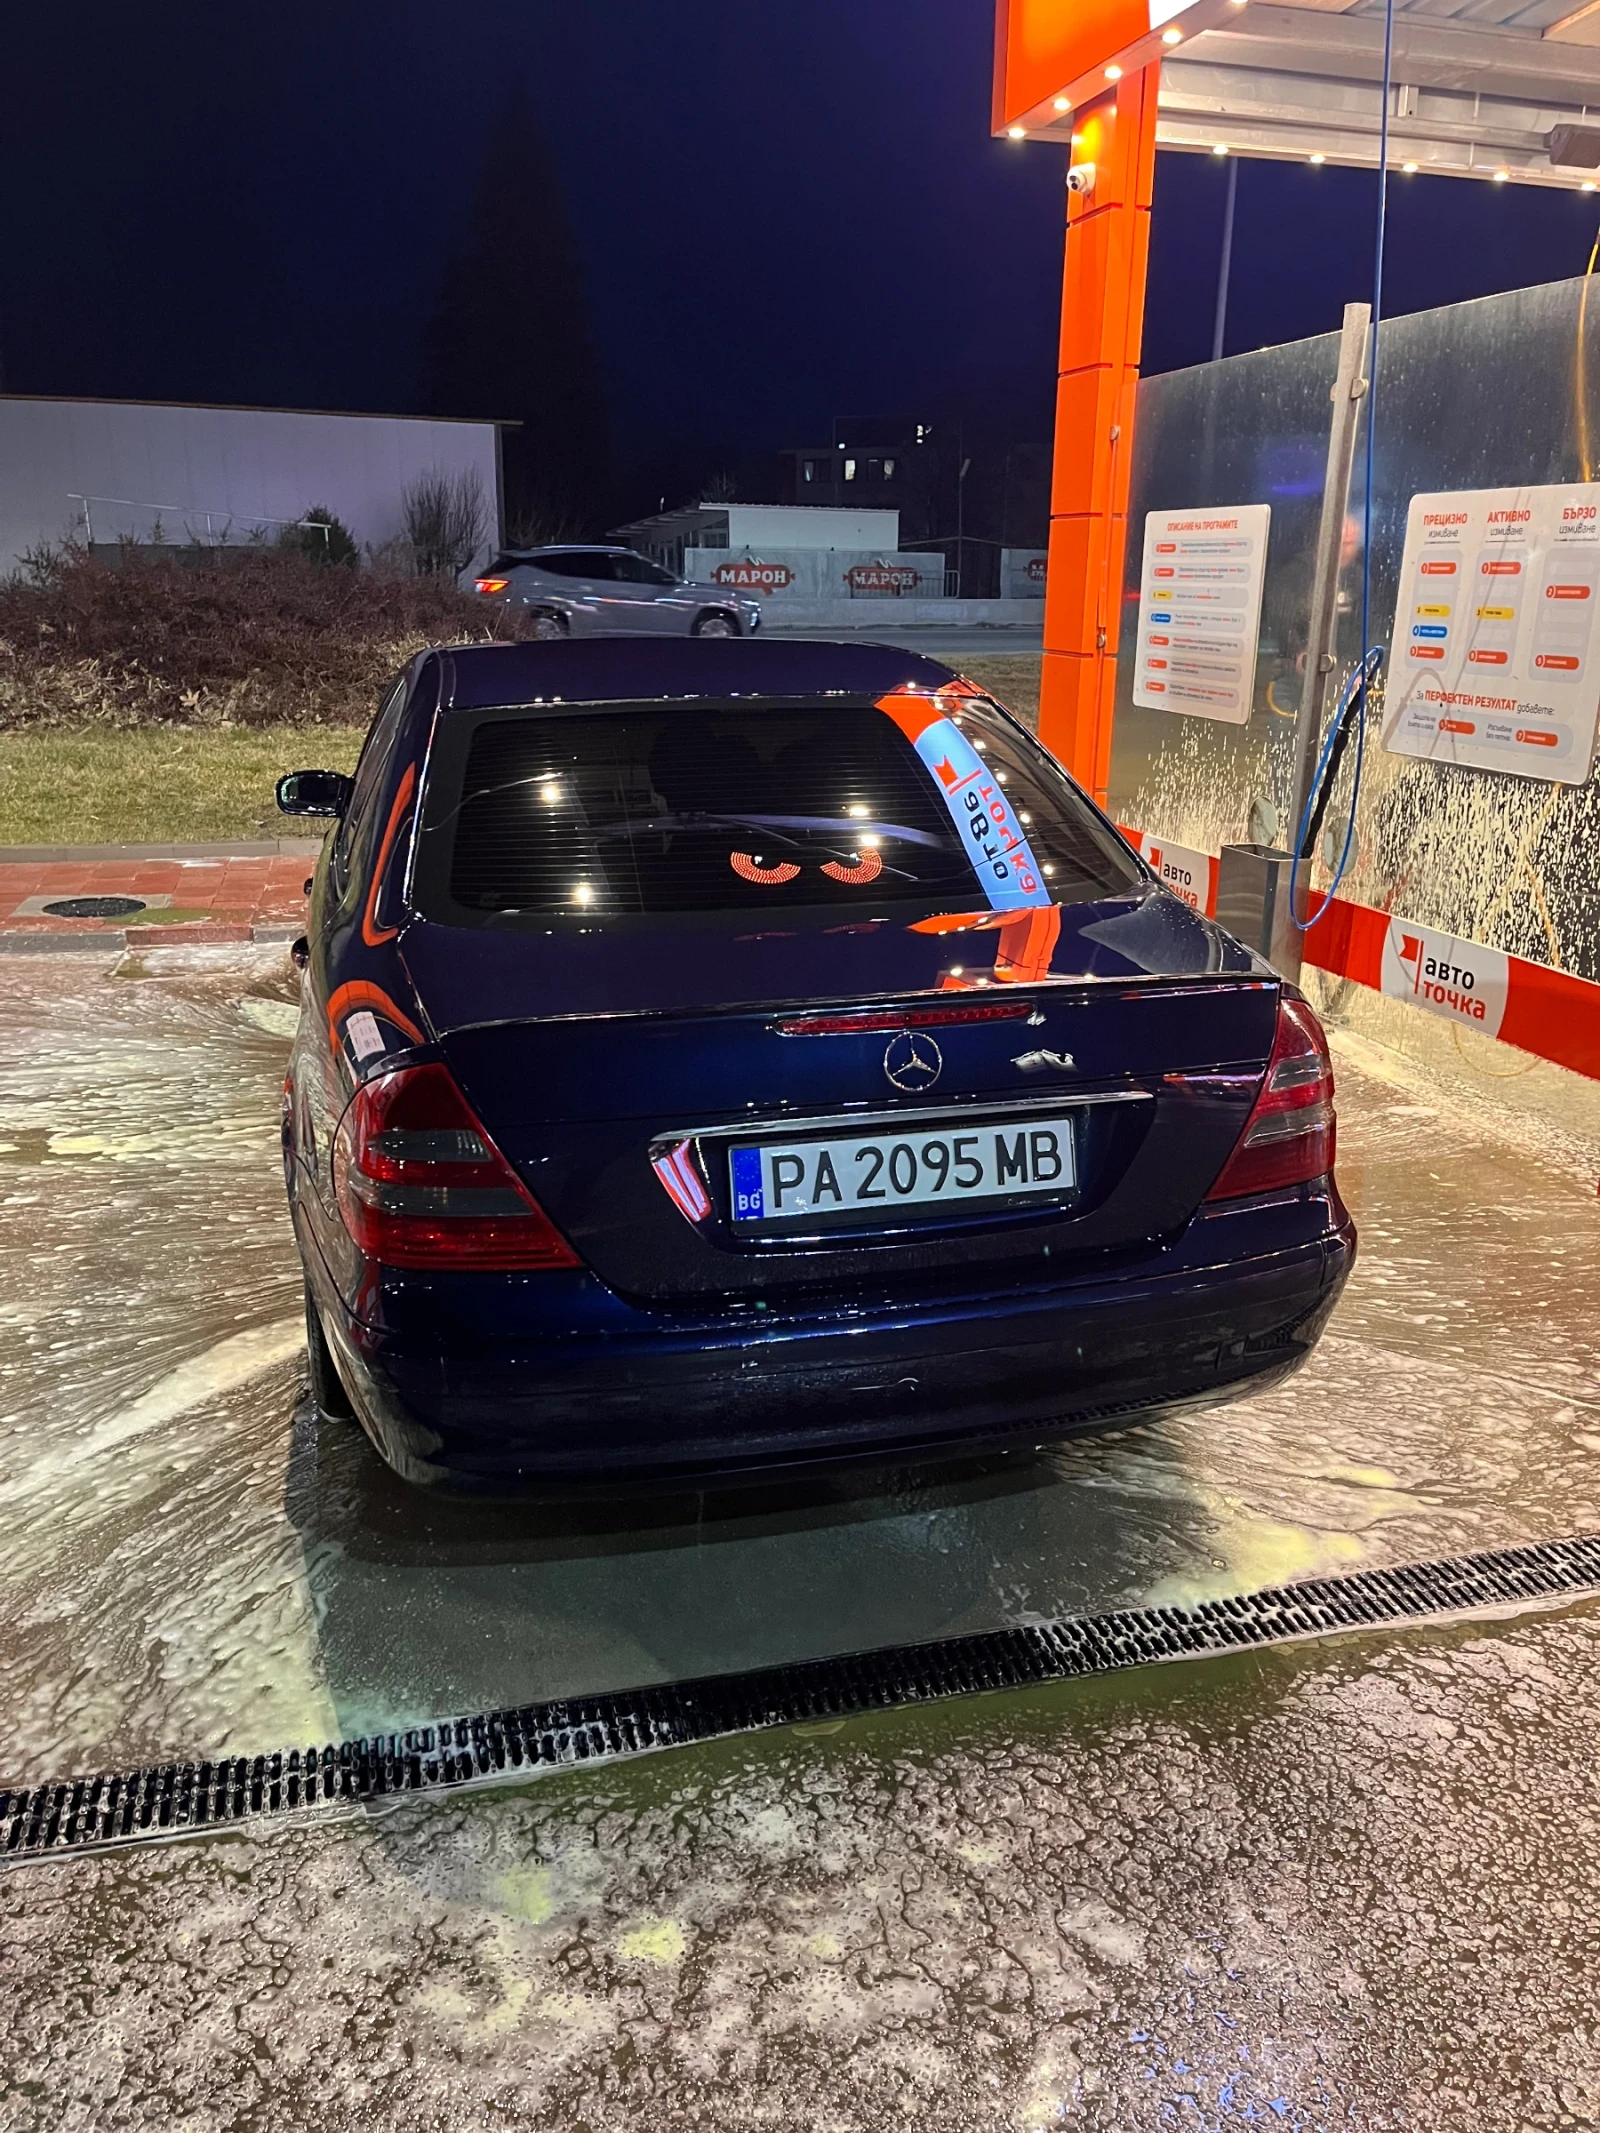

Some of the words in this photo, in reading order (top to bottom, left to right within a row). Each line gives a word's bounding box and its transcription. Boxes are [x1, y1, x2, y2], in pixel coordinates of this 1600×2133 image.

[1424, 513, 1468, 526] ПРЕЦИЗНО
[1487, 510, 1531, 523] АКТИВНО
[1563, 507, 1597, 520] БЪРЗО
[1167, 522, 1194, 532] ОПИСАНИЕ
[1195, 521, 1202, 530] НА
[1203, 519, 1238, 530] ПРОГРАМИТЕ
[1428, 527, 1459, 538] измиване
[1490, 525, 1524, 536] измиване
[1559, 522, 1596, 534] измиване
[720, 570, 787, 584] МАРОН
[853, 571, 914, 586] МАРОН
[1416, 691, 1424, 700] За
[1425, 690, 1474, 706] ПЕРФЕКТЕН
[1475, 696, 1518, 711] РЕЗУЛТАТ
[1517, 703, 1555, 716] добавете:
[1163, 863, 1192, 886] авто
[1425, 957, 1475, 990] авто
[1423, 980, 1487, 1020] точка
[771, 1150, 843, 1209] PA
[854, 1136, 984, 1200] 2095
[994, 1129, 1063, 1186] MB
[738, 1195, 761, 1211] BG
